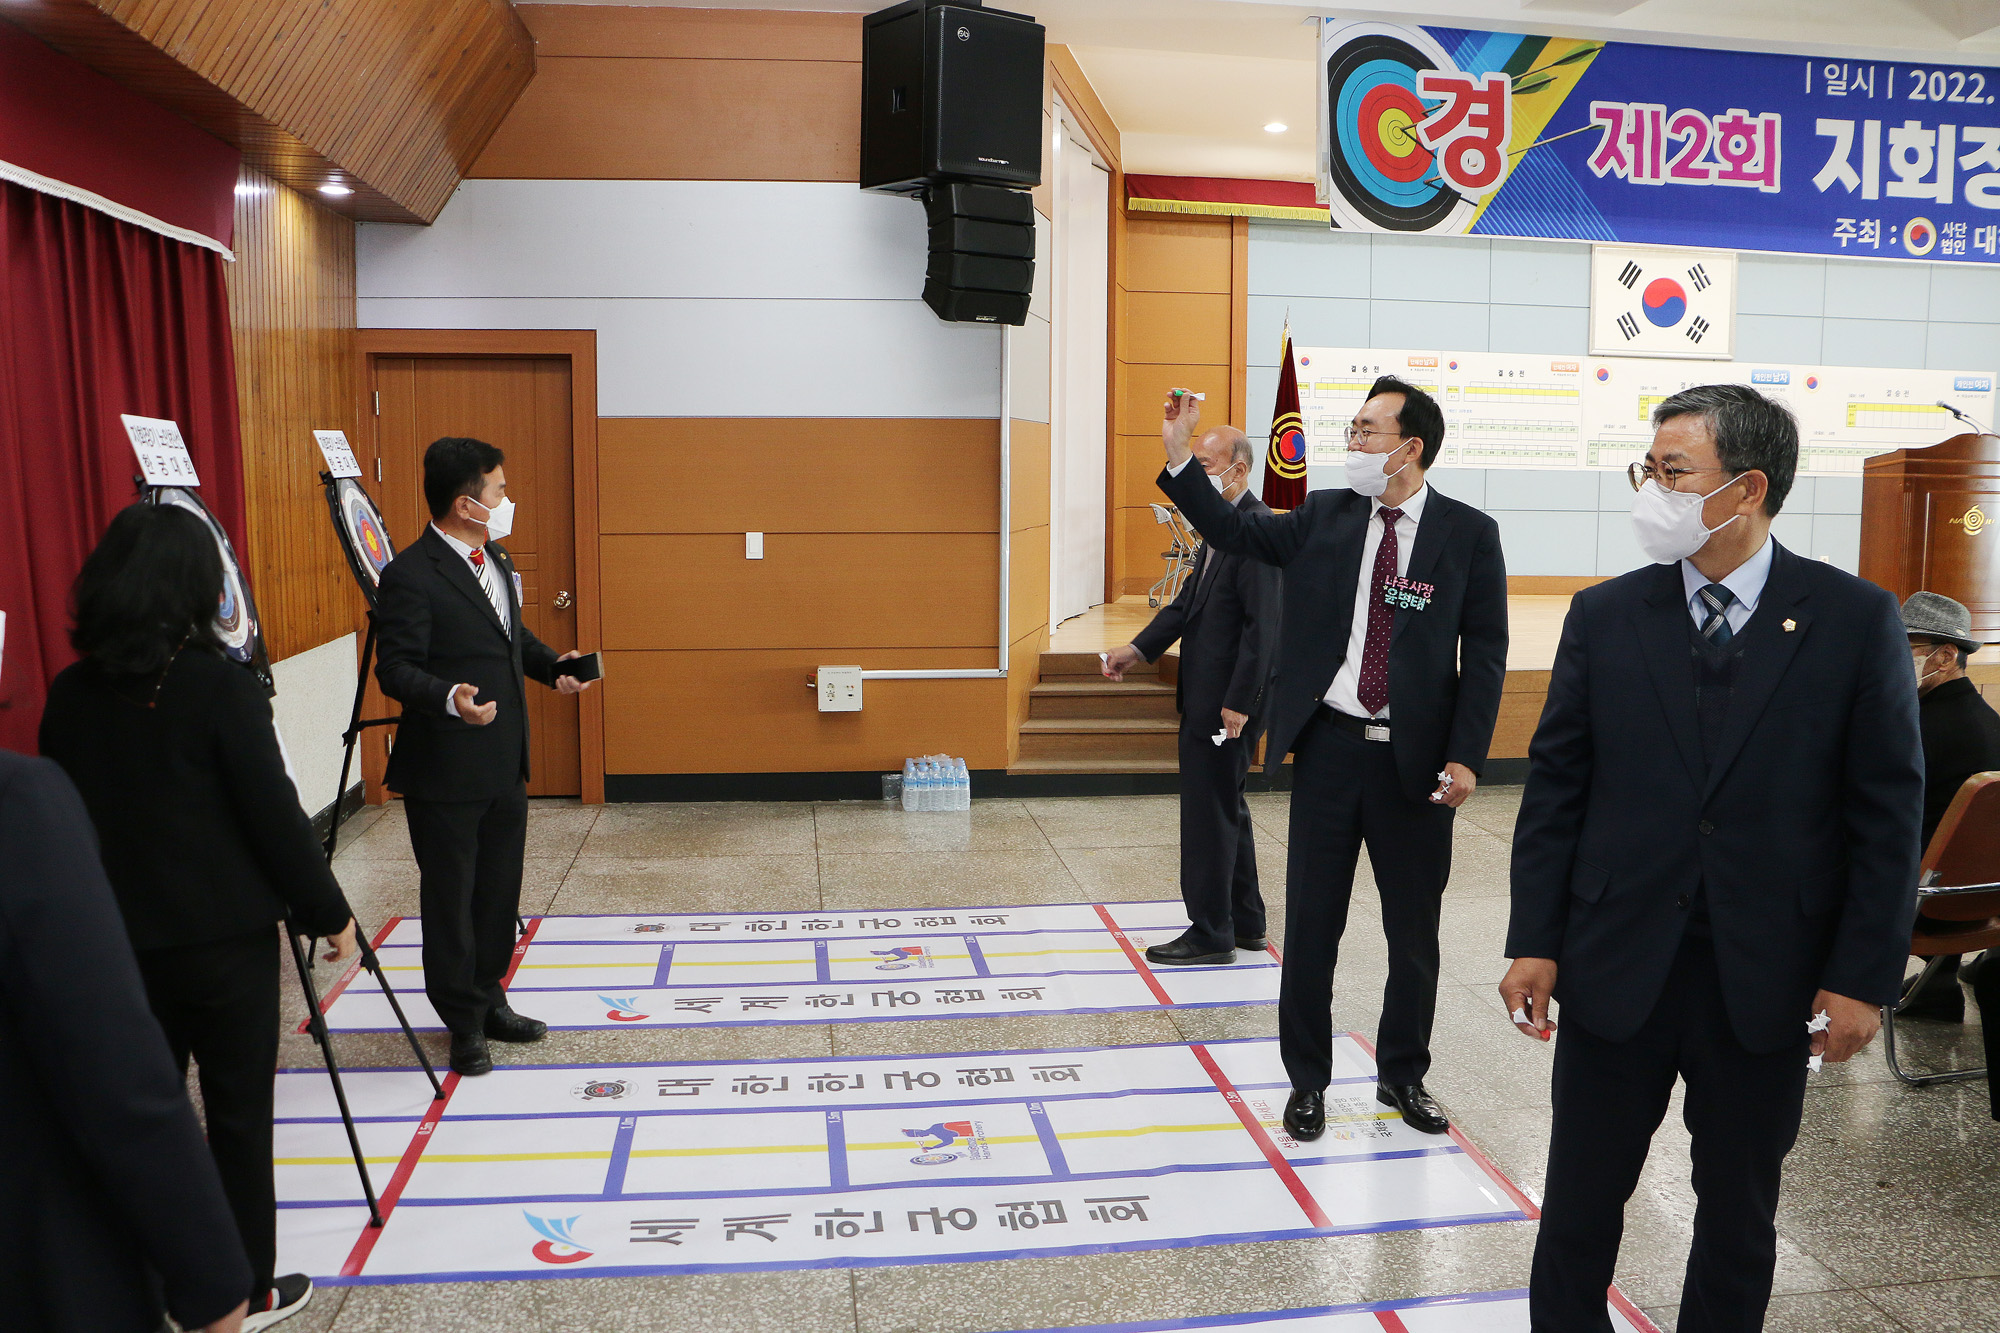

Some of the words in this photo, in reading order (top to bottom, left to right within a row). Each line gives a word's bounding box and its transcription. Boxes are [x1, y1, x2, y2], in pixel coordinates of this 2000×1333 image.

[1824, 63, 1875, 99] 일시
[1909, 69, 1995, 105] 2022.
[1419, 76, 1507, 189] 경
[1590, 105, 1779, 190] 제2회
[1832, 217, 1880, 249] 주최
[1941, 222, 1968, 238] 사단
[1940, 239, 1967, 255] 법인
[1385, 574, 1434, 598] 나주시장
